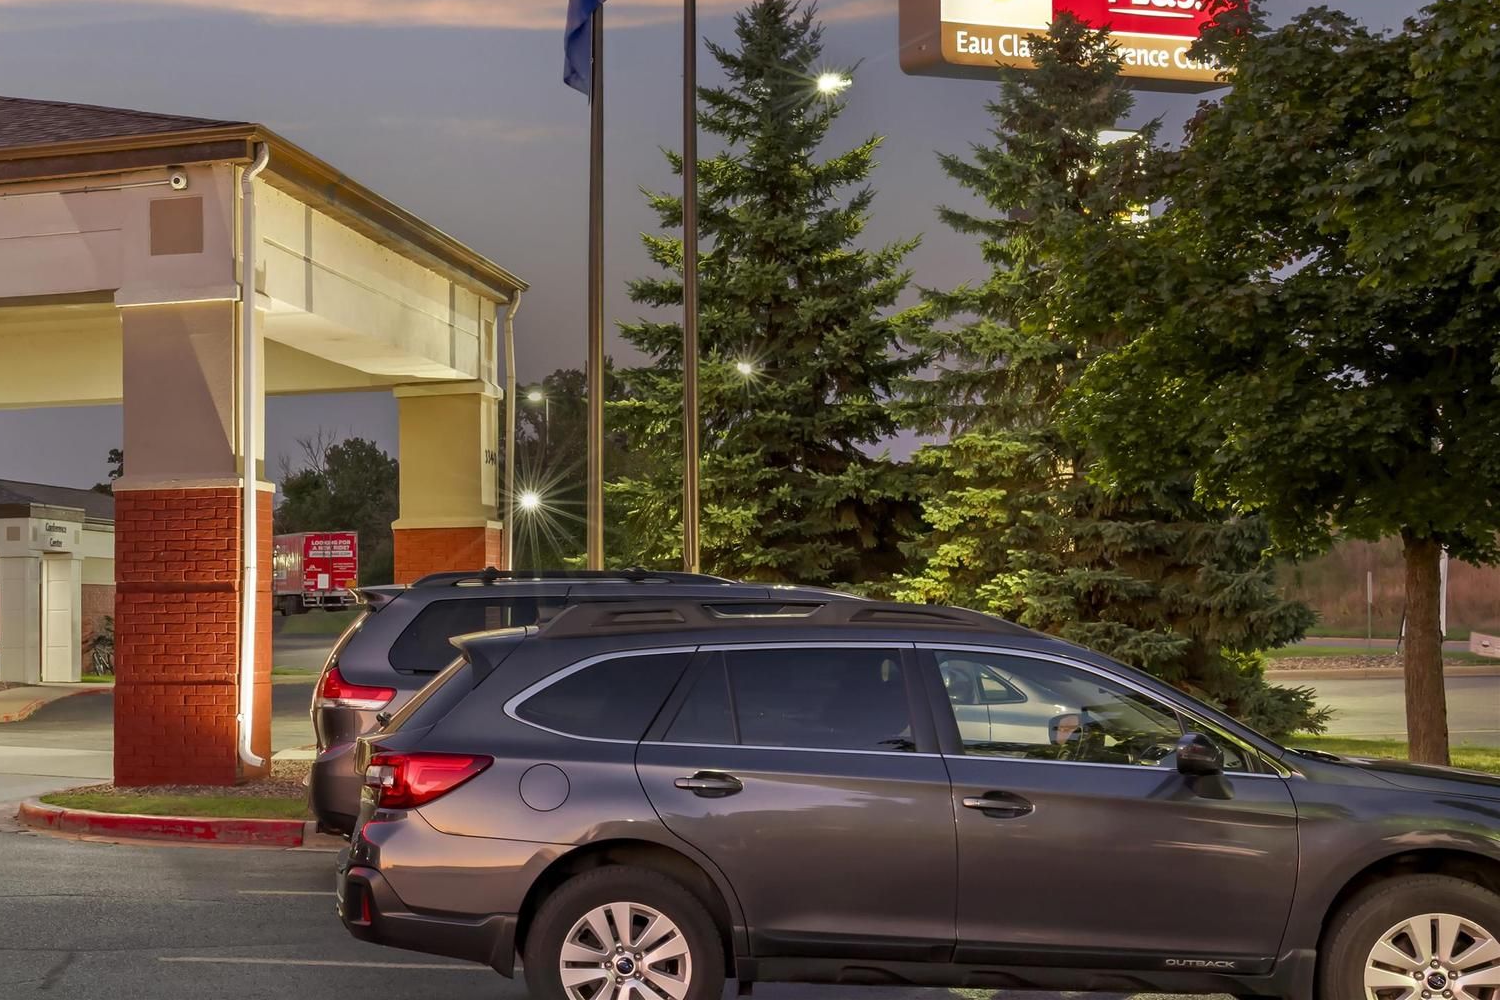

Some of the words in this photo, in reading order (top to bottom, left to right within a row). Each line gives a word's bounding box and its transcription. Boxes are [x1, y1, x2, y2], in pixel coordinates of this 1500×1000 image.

[956, 30, 994, 56] Eau
[998, 33, 1038, 58] Cla
[1165, 959, 1235, 968] OUTBACK
